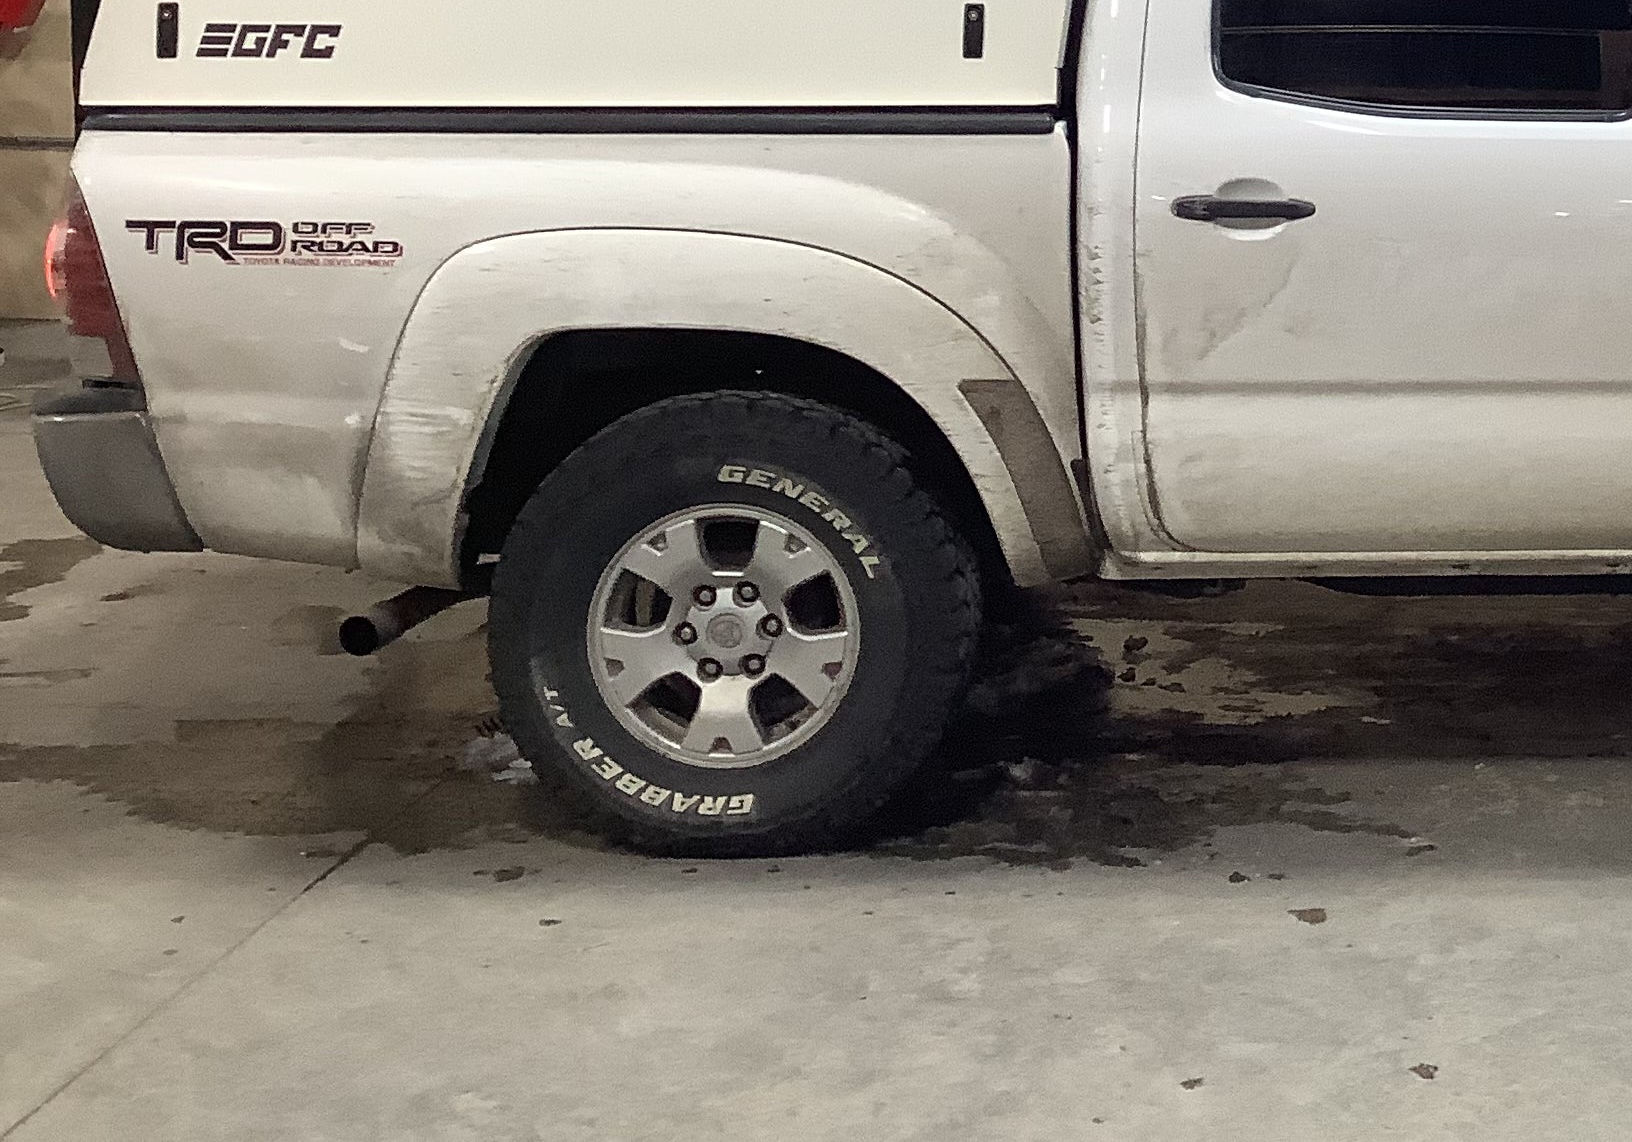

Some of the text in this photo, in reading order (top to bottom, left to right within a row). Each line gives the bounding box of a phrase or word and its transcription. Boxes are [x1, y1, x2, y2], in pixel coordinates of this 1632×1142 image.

[125, 219, 287, 265] TRD
[291, 221, 376, 239] OFF
[243, 257, 280, 266] TOYOTA
[290, 239, 404, 257] ROAD
[716, 464, 881, 580] GENERAL
[572, 736, 756, 816] GRABBER
